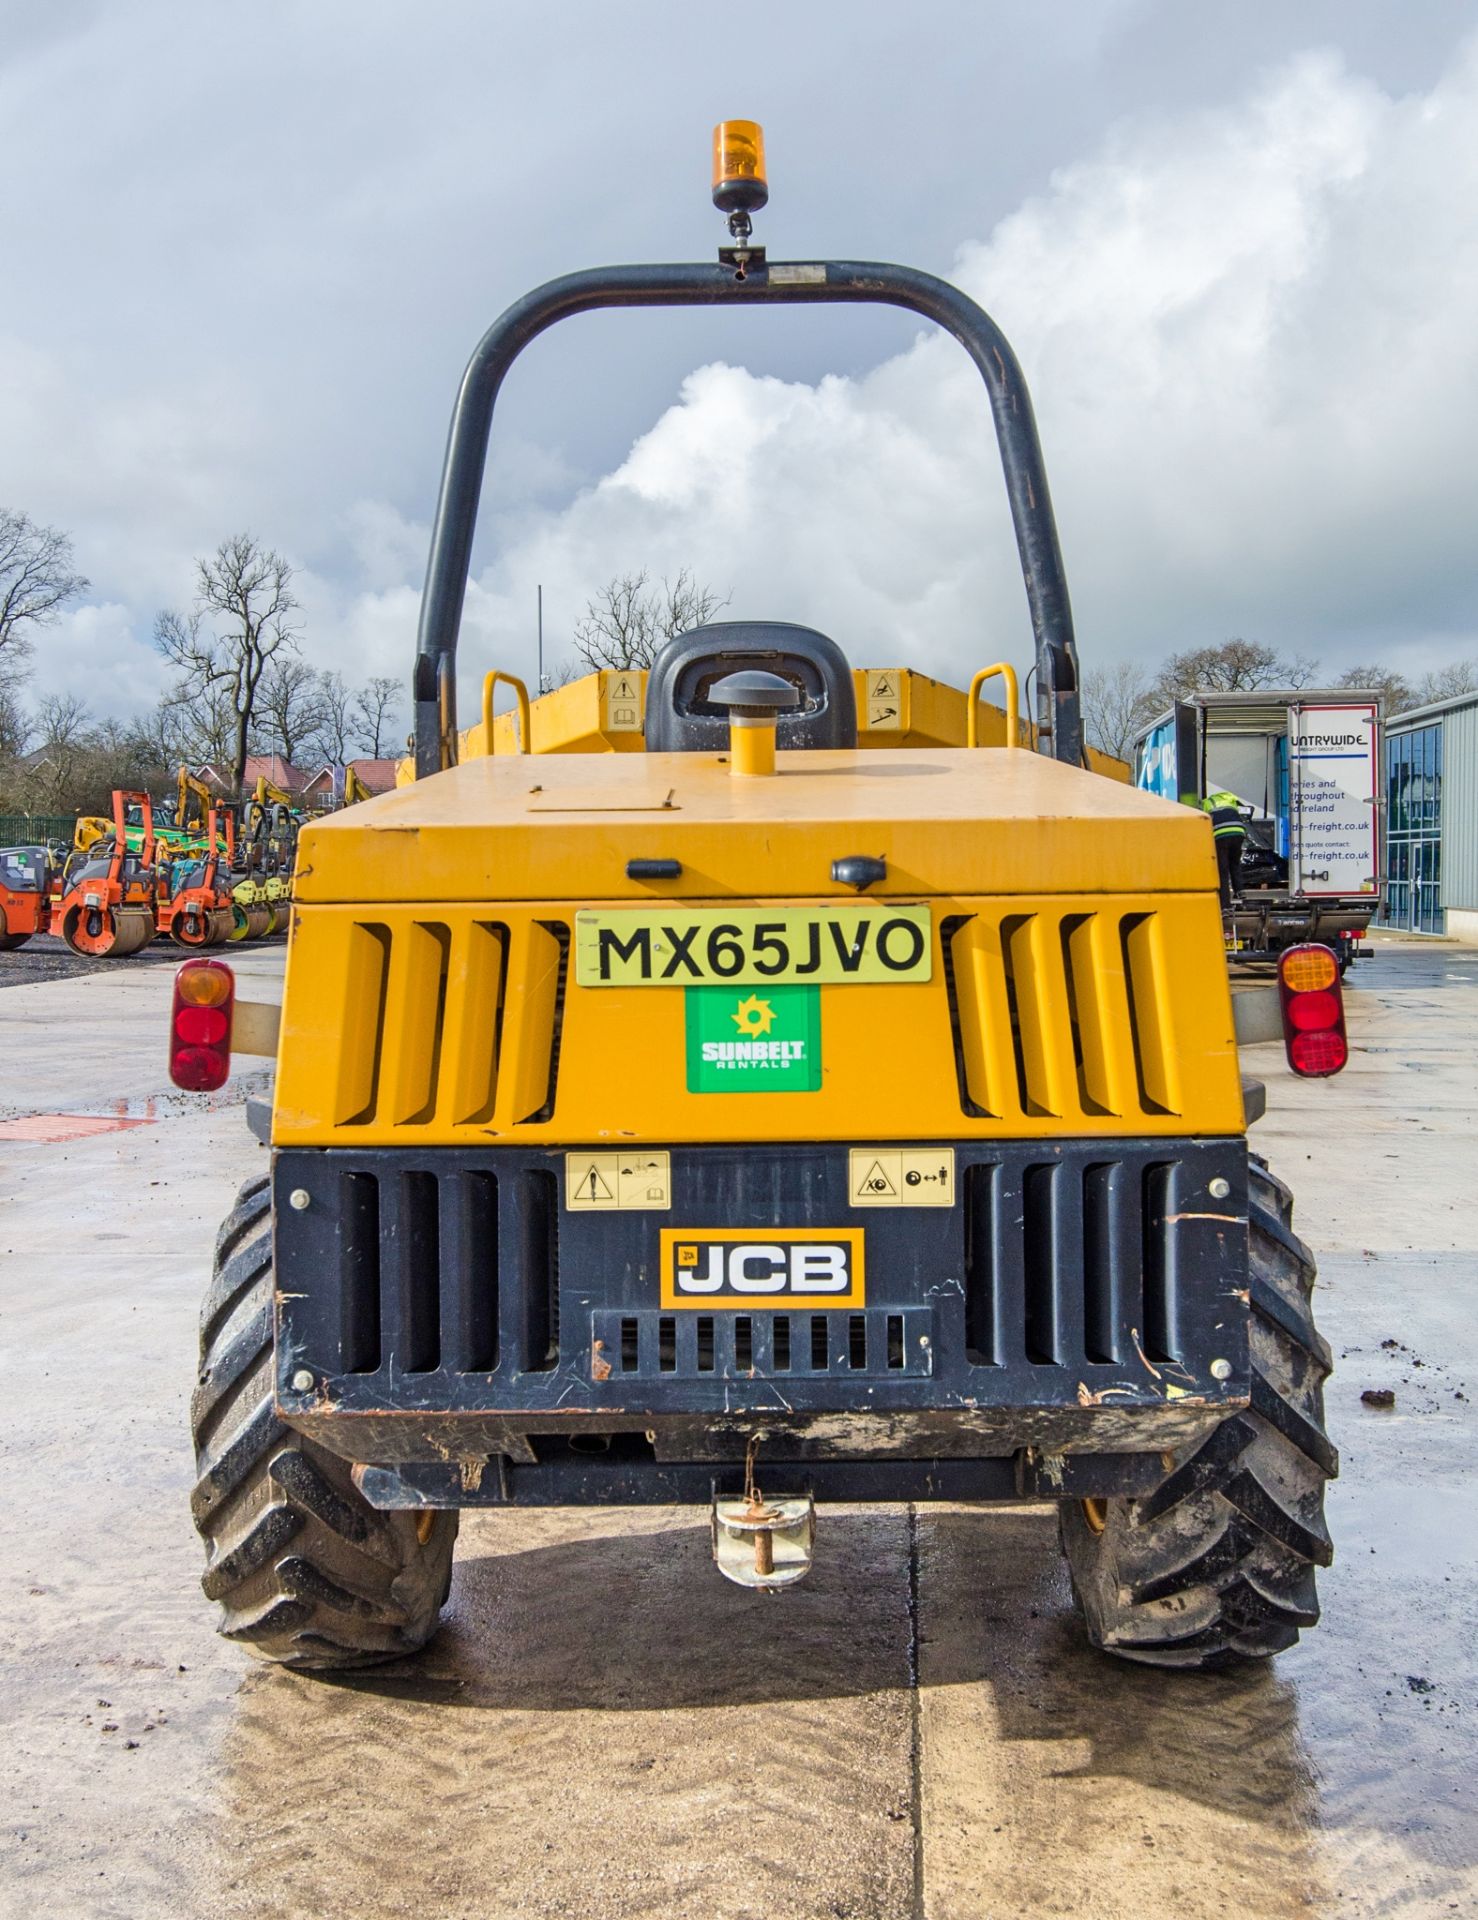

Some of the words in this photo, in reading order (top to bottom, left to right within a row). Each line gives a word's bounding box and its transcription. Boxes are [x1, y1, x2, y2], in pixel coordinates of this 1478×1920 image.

[1318, 780, 1336, 788] and
[1302, 803, 1335, 813] Ireland
[598, 918, 925, 980] MX65JVO
[702, 1041, 805, 1061] SUNBELT
[716, 1060, 790, 1069] RENTALS
[678, 1245, 848, 1292] JCB
